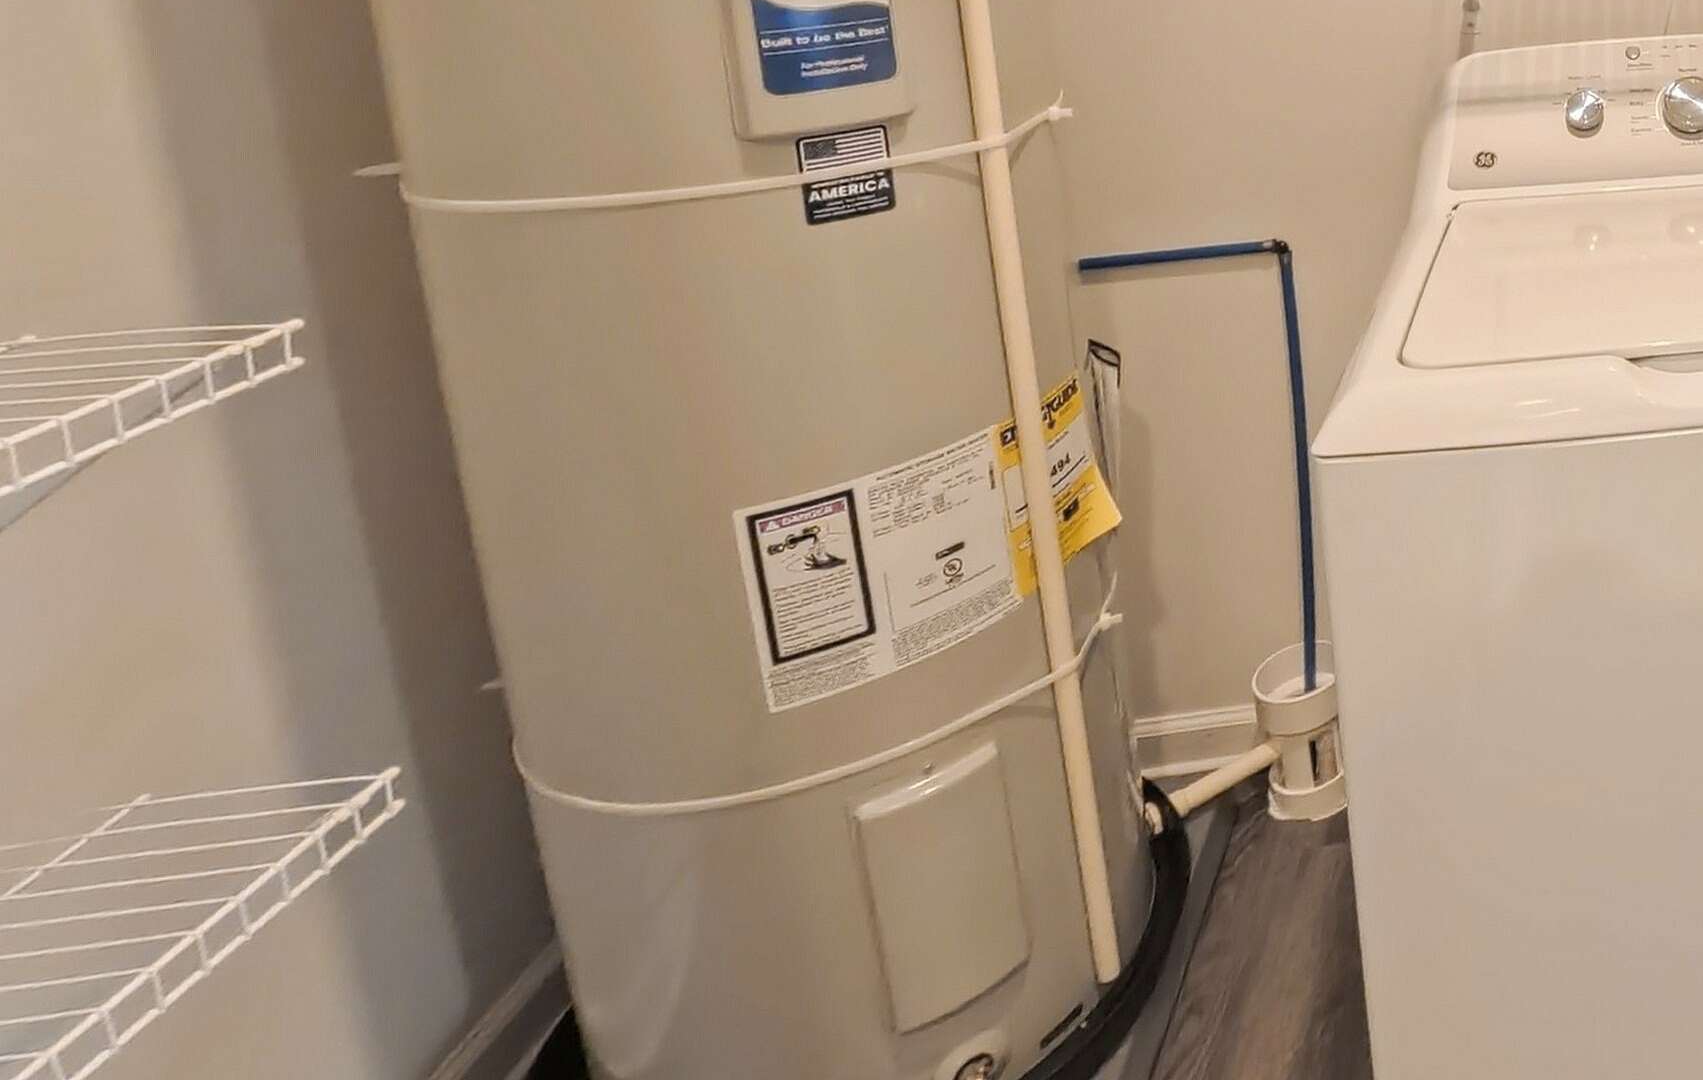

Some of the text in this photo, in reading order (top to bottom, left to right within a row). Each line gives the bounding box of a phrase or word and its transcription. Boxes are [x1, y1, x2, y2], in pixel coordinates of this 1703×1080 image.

[760, 36, 793, 49] Built
[796, 35, 810, 45] to
[813, 32, 831, 43] be
[835, 29, 856, 40] the
[808, 176, 890, 204] AMERICA
